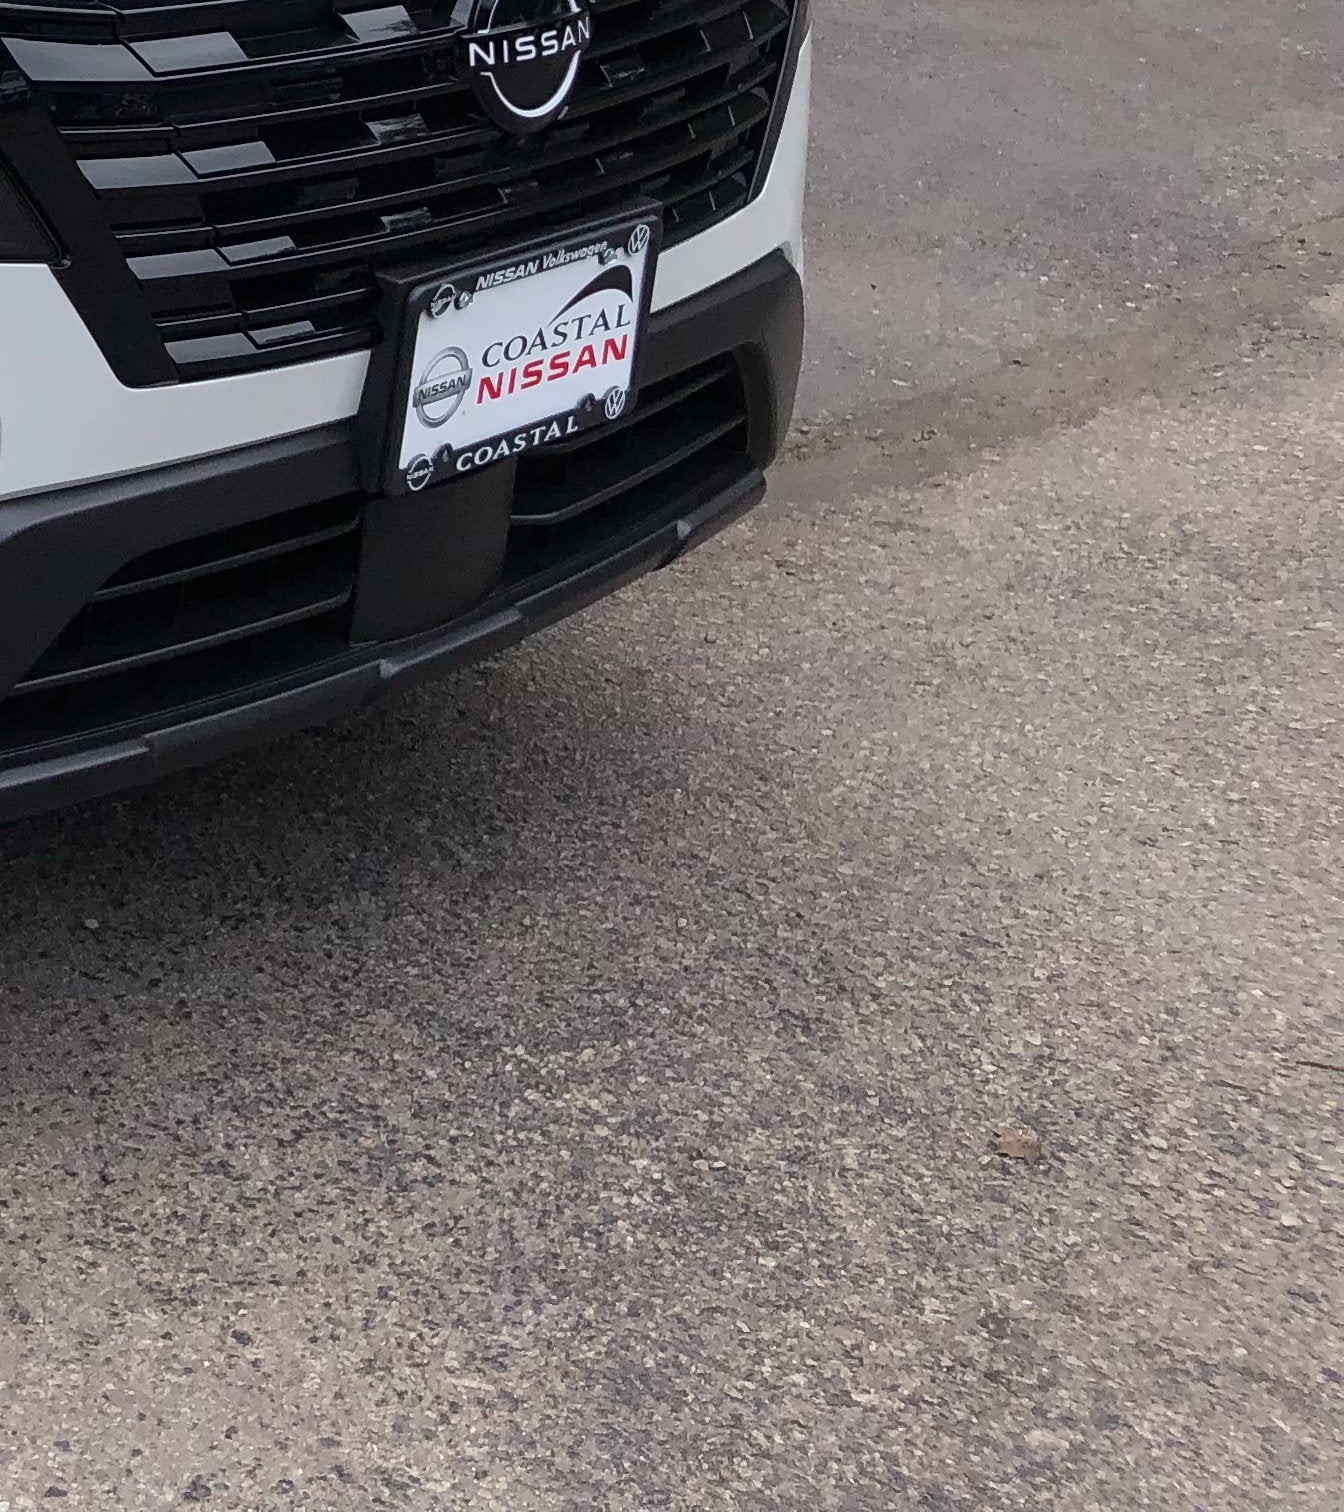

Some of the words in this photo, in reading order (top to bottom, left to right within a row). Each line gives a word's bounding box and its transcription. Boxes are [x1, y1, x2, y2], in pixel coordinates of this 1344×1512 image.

[468, 16, 590, 67] NISSAN
[474, 259, 540, 291] NISSAN
[541, 241, 609, 271] Volkswagen
[481, 303, 631, 368] COASTAL
[418, 374, 467, 401] NISSAN
[476, 333, 629, 405] NISSAN
[456, 415, 579, 473] COASTAL
